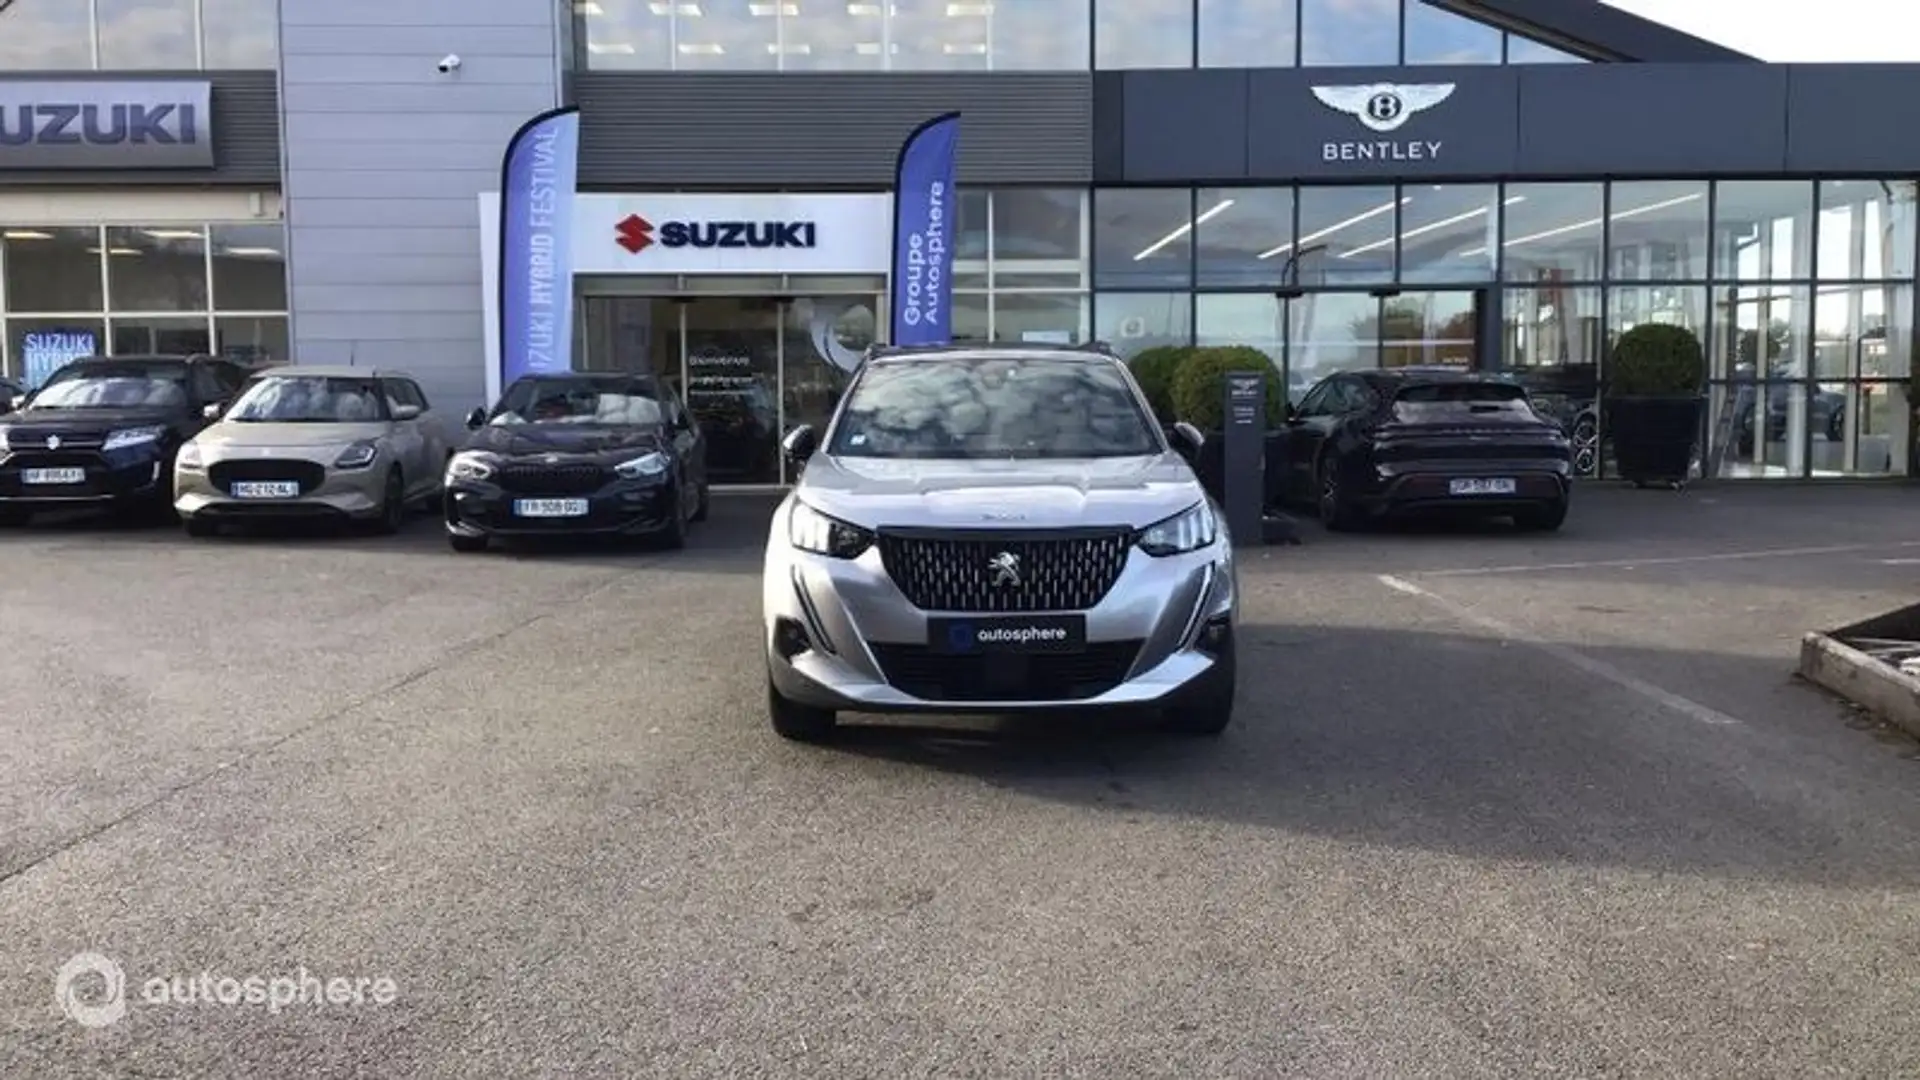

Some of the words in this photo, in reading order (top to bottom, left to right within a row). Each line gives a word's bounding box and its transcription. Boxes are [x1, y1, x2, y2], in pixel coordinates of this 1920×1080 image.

[1322, 141, 1442, 160] BENTLEY
[530, 125, 559, 227] FESTIVAL
[659, 220, 816, 248] SUZUKI
[924, 180, 945, 326] Autosphere
[529, 234, 555, 304] HYBRID
[903, 232, 926, 327] Groupe
[25, 332, 94, 352] SUZUKI
[977, 626, 1067, 644] autosphere
